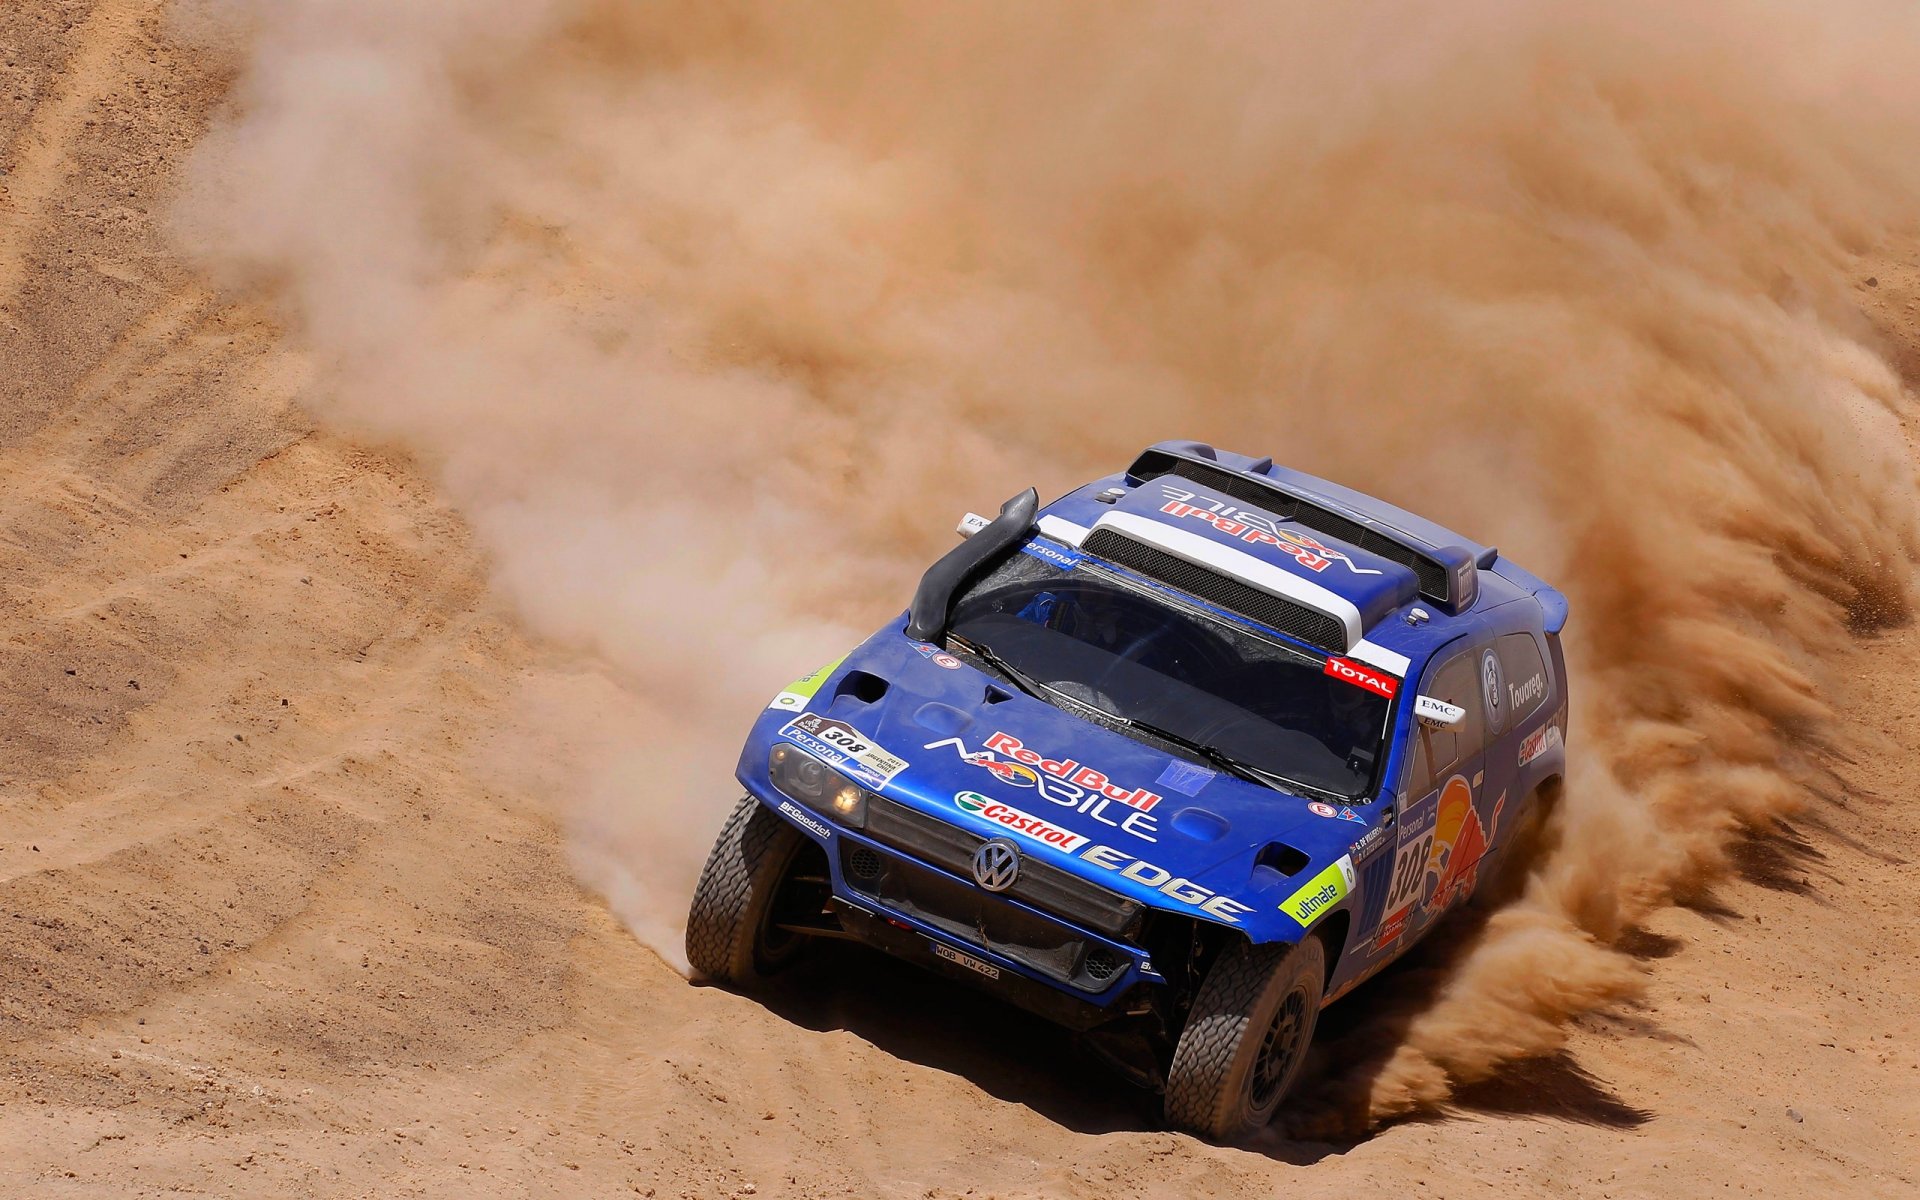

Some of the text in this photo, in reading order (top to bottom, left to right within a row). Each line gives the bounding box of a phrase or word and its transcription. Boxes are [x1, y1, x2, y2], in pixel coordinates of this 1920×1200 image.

[968, 518, 988, 527] EM
[1026, 541, 1079, 566] ersonal
[1329, 659, 1393, 694] TOTAL
[787, 728, 850, 764] Personal
[824, 731, 868, 753] 308
[876, 763, 891, 773] CHILE
[779, 801, 831, 838] BFGoodrich
[983, 805, 1078, 849] Castrol
[1079, 844, 1257, 923] EDGE
[1296, 884, 1338, 919] ultimate
[936, 945, 998, 978] WOB VW 422
